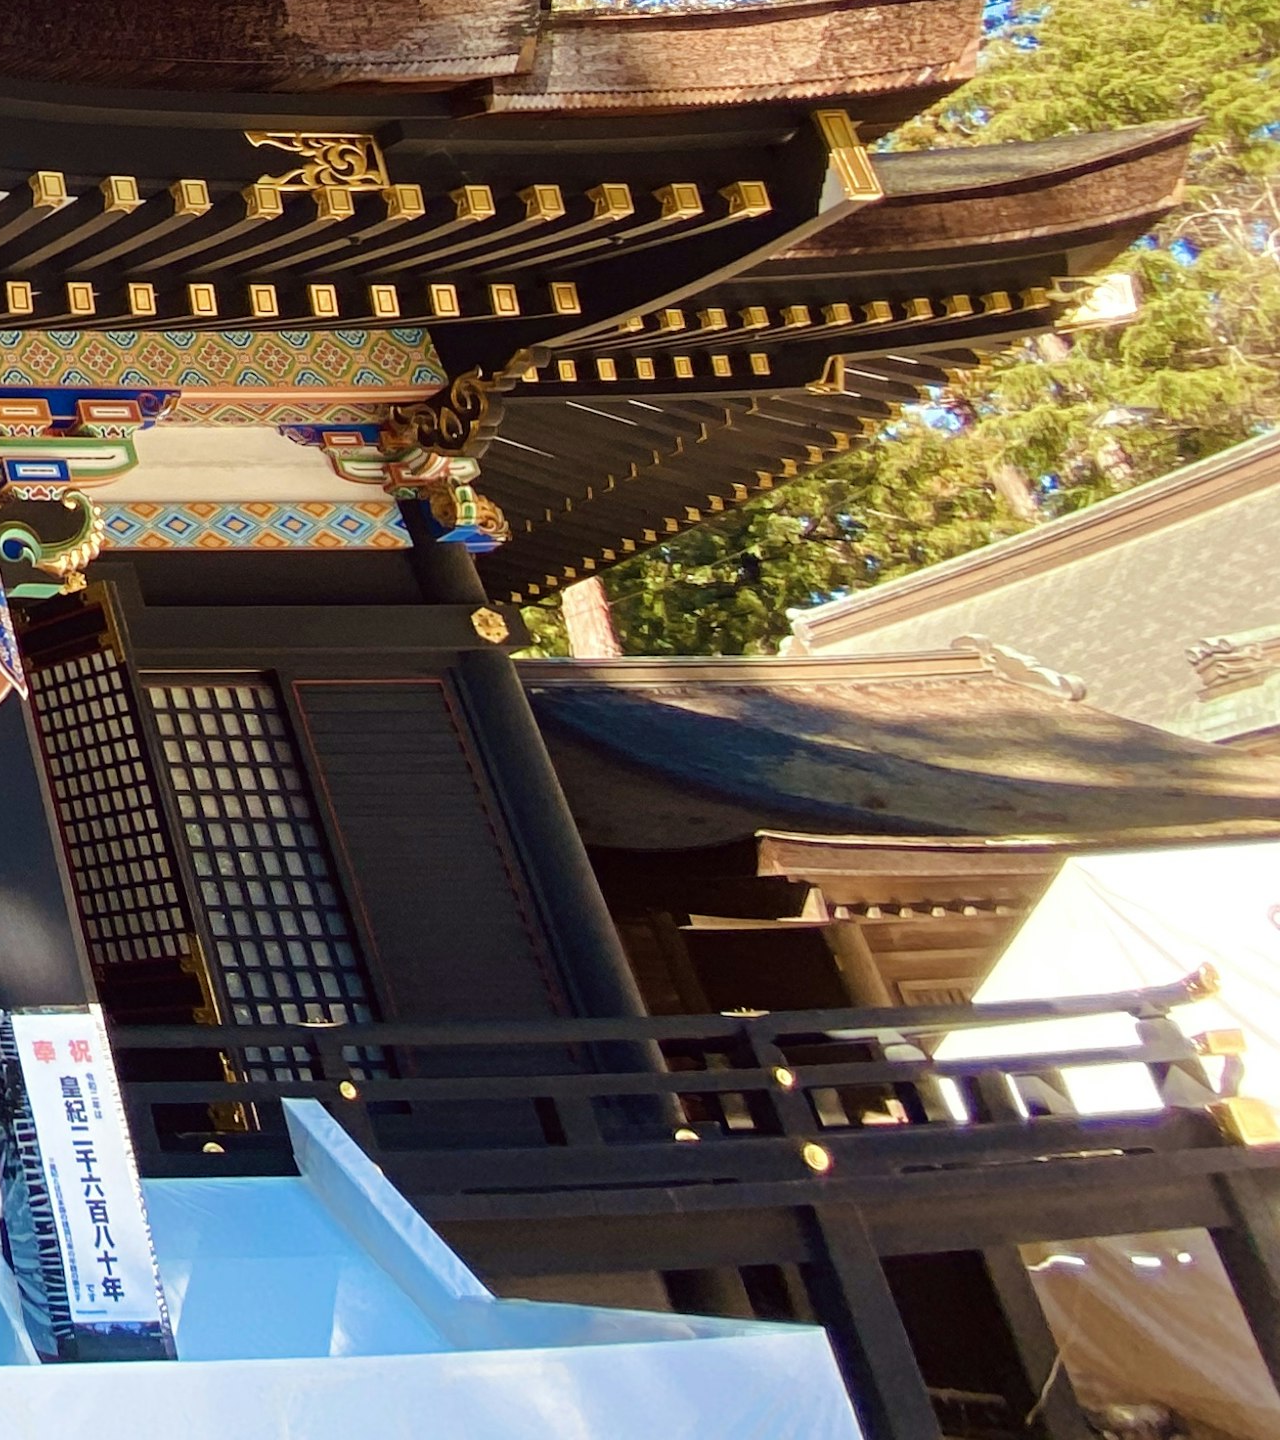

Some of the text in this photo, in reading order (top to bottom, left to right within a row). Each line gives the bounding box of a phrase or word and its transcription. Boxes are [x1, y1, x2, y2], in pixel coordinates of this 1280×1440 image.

[32, 1039, 92, 1063] 奉祝
[59, 1075, 125, 1302] 皇紀二千六百八十年
